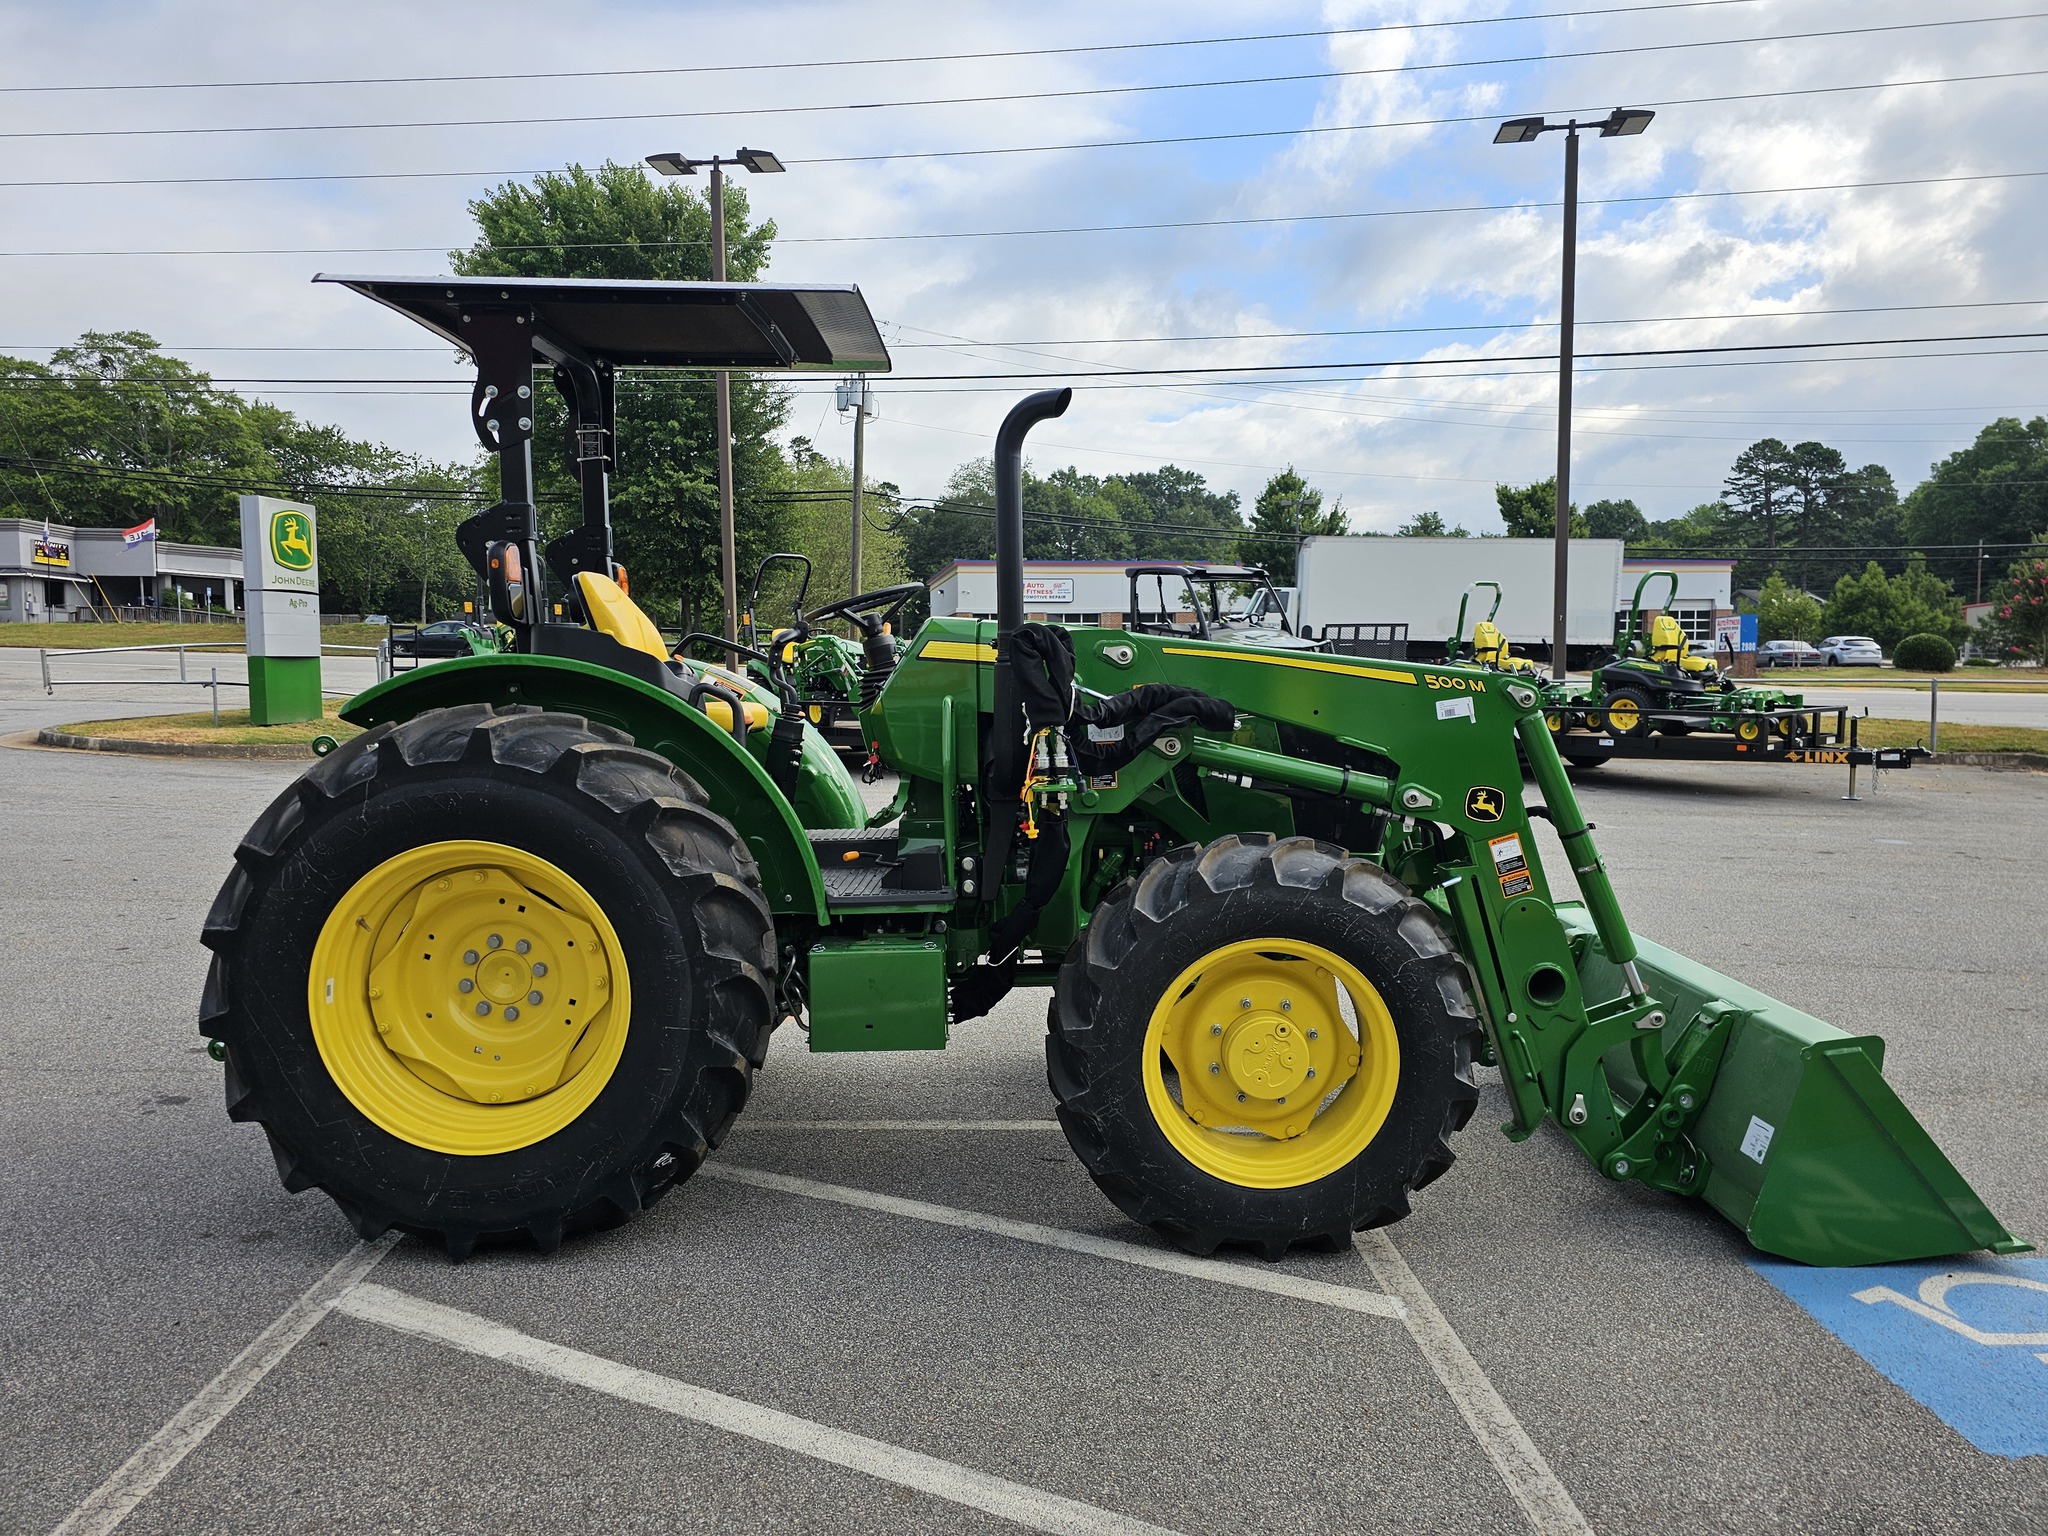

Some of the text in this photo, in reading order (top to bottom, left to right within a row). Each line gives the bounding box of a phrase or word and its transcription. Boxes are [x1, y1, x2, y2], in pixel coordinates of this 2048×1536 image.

[272, 575, 315, 587] JOHN DEERE
[289, 598, 308, 608] Ag-Pro
[1741, 642, 1756, 651] 2800
[1424, 674, 1487, 693] 500 M
[1804, 751, 1849, 764] LINX
